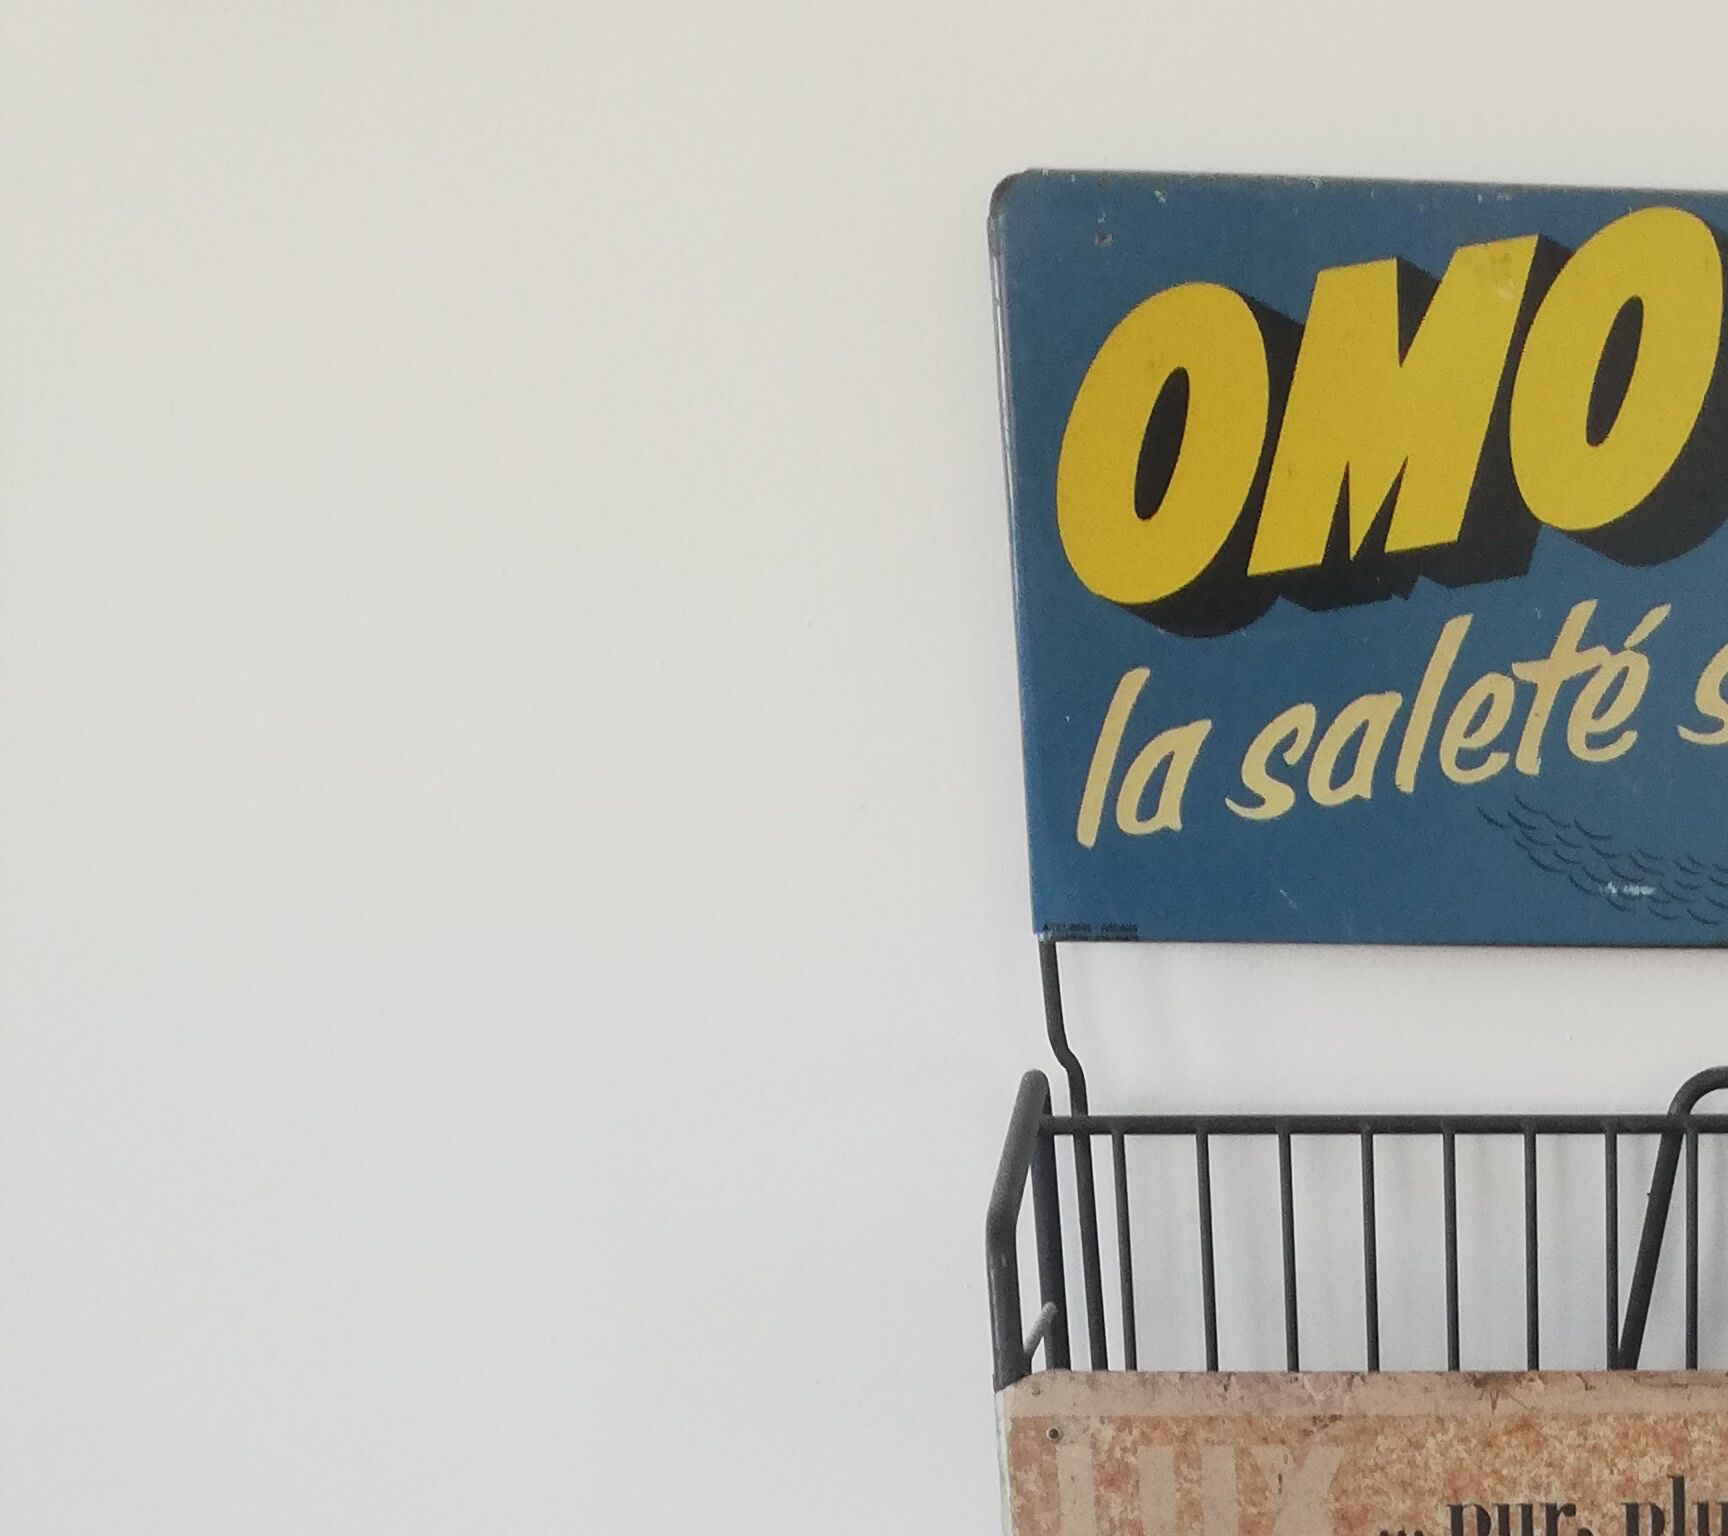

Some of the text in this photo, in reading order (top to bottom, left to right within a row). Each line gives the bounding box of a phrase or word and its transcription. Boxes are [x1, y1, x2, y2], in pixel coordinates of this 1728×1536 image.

[1057, 206, 1724, 605] OMO
[1076, 666, 1212, 849] la
[1225, 599, 1671, 820] saleté
